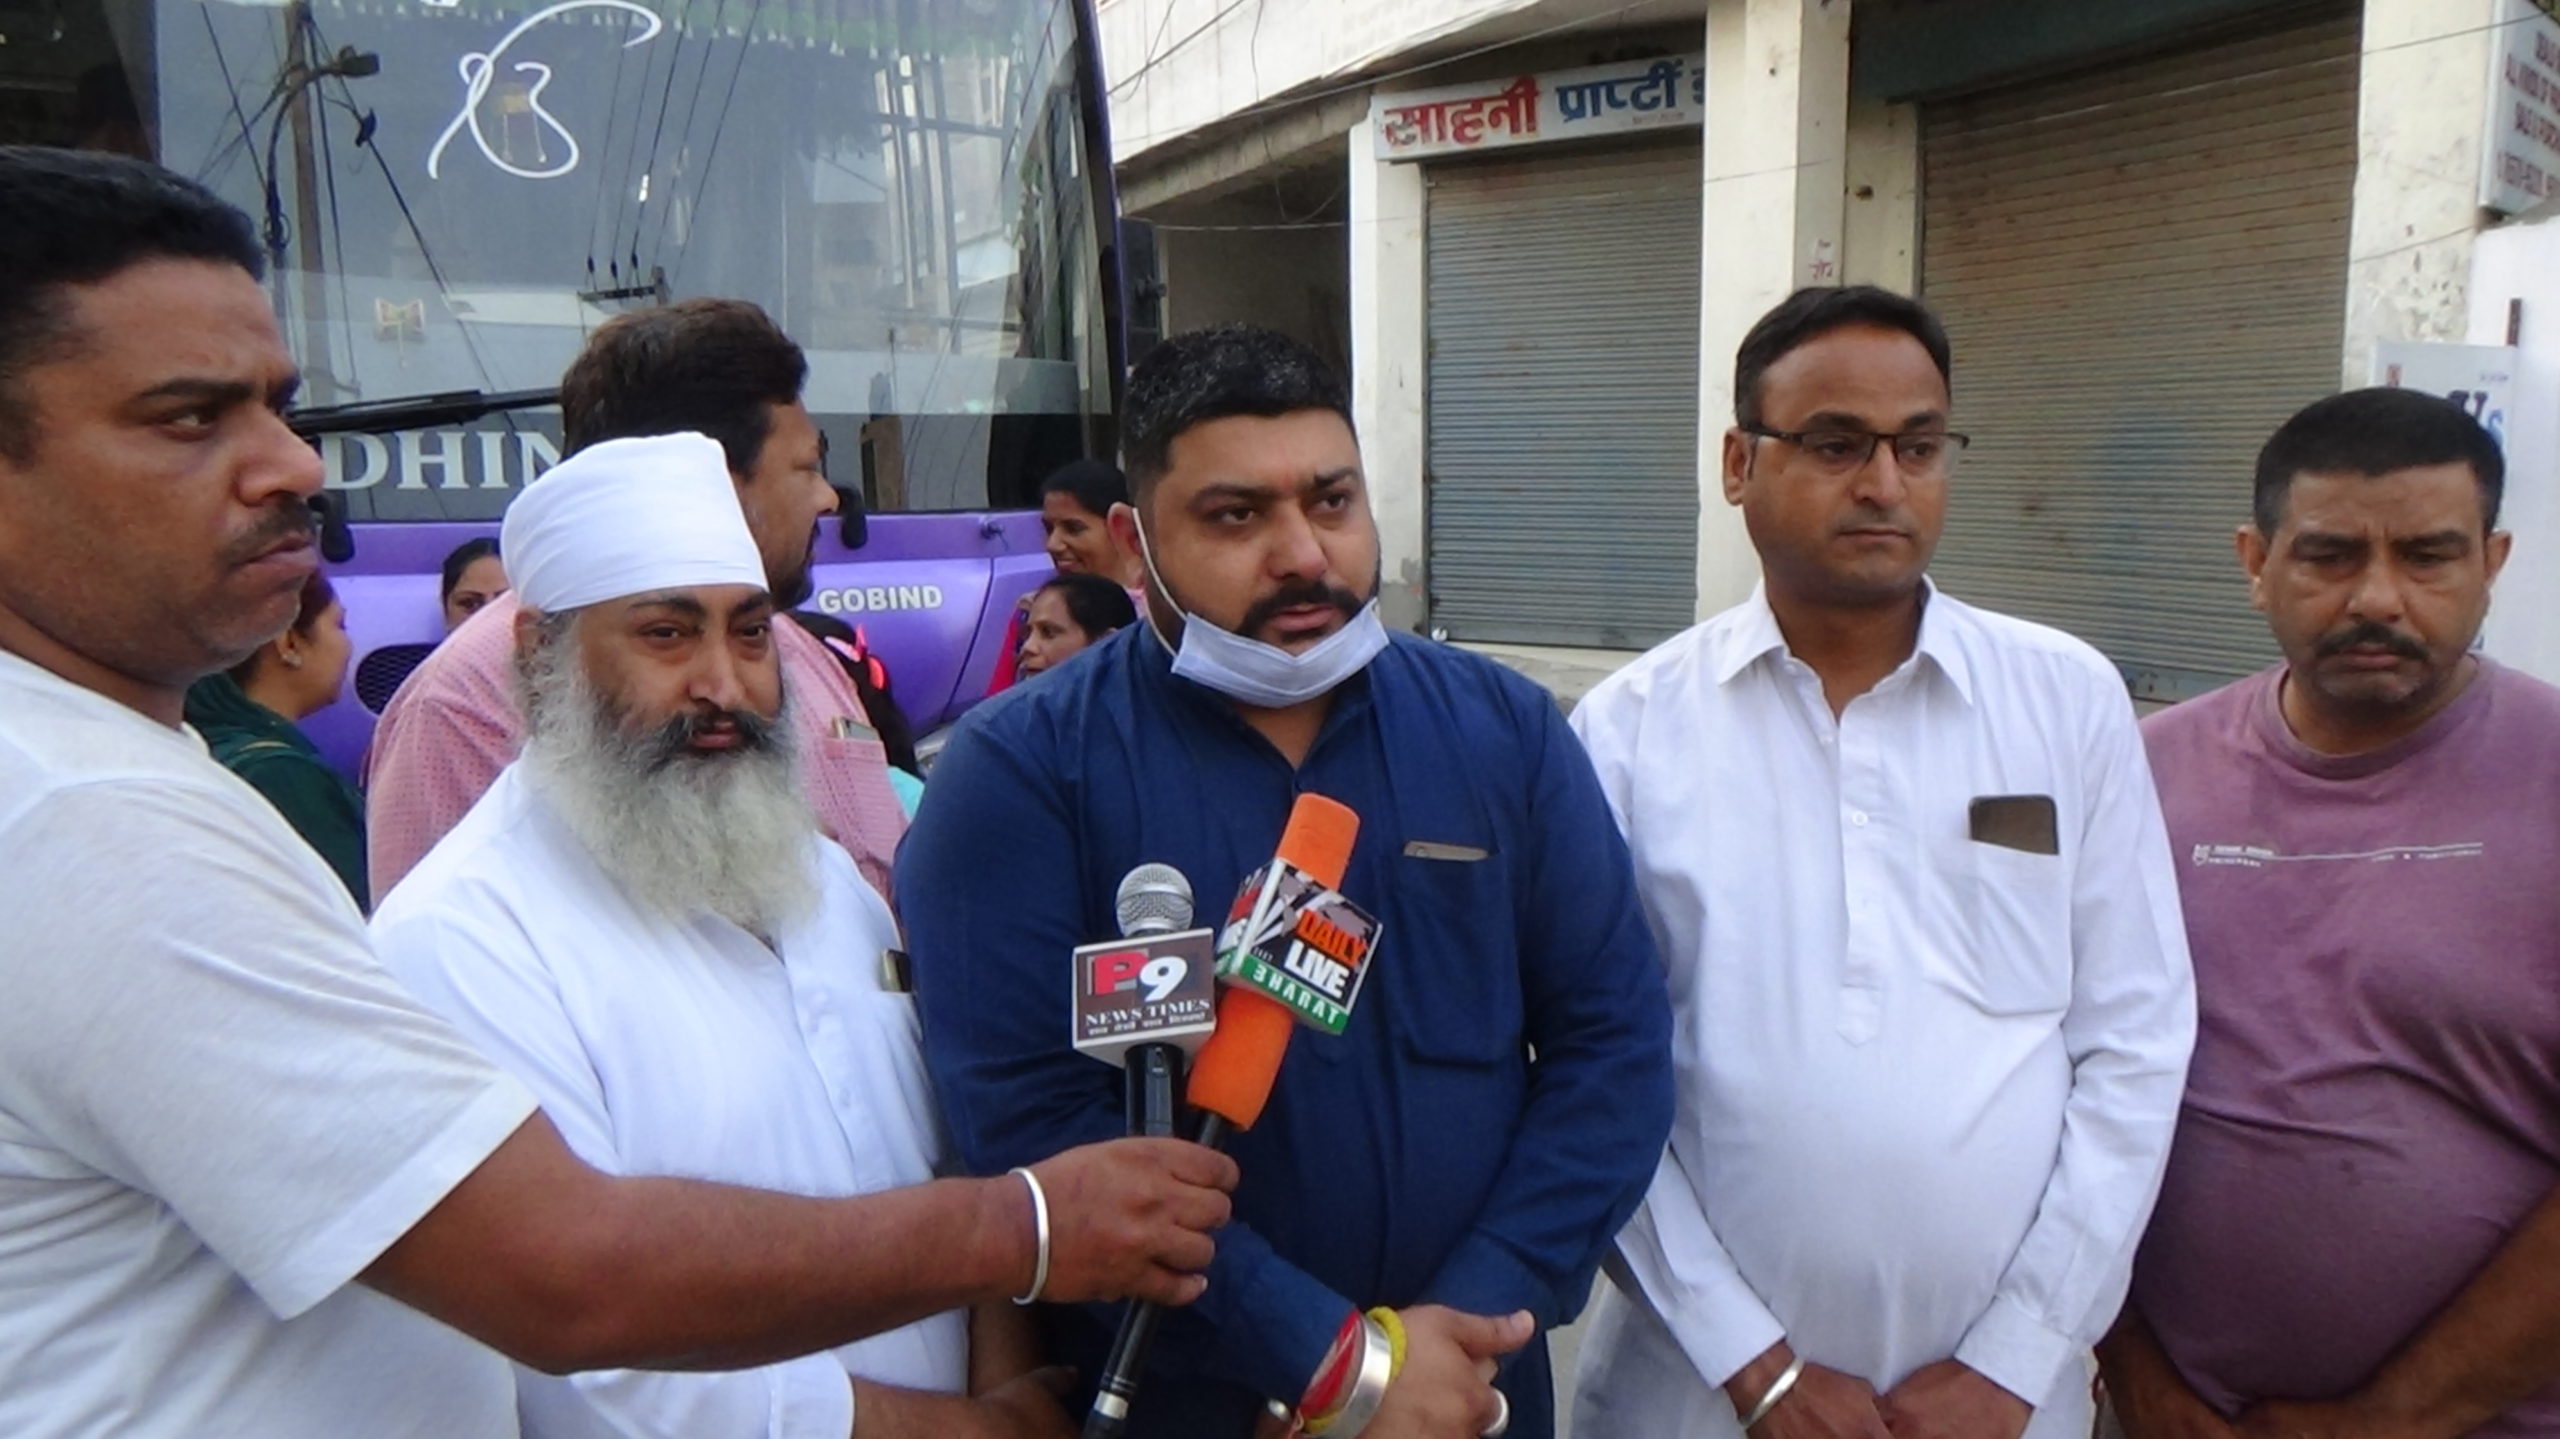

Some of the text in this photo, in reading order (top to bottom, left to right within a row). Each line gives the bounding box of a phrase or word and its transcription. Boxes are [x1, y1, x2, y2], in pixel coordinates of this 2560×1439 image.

[1384, 76, 1540, 147] साहनी
[817, 584, 944, 615] GOBIND
[1296, 908, 1368, 969] DAILY
[1087, 948, 1188, 1003] P9
[1283, 938, 1350, 999] LIVE
[1085, 1008, 1142, 1027] NEWS
[1147, 999, 1210, 1018] TIMES
